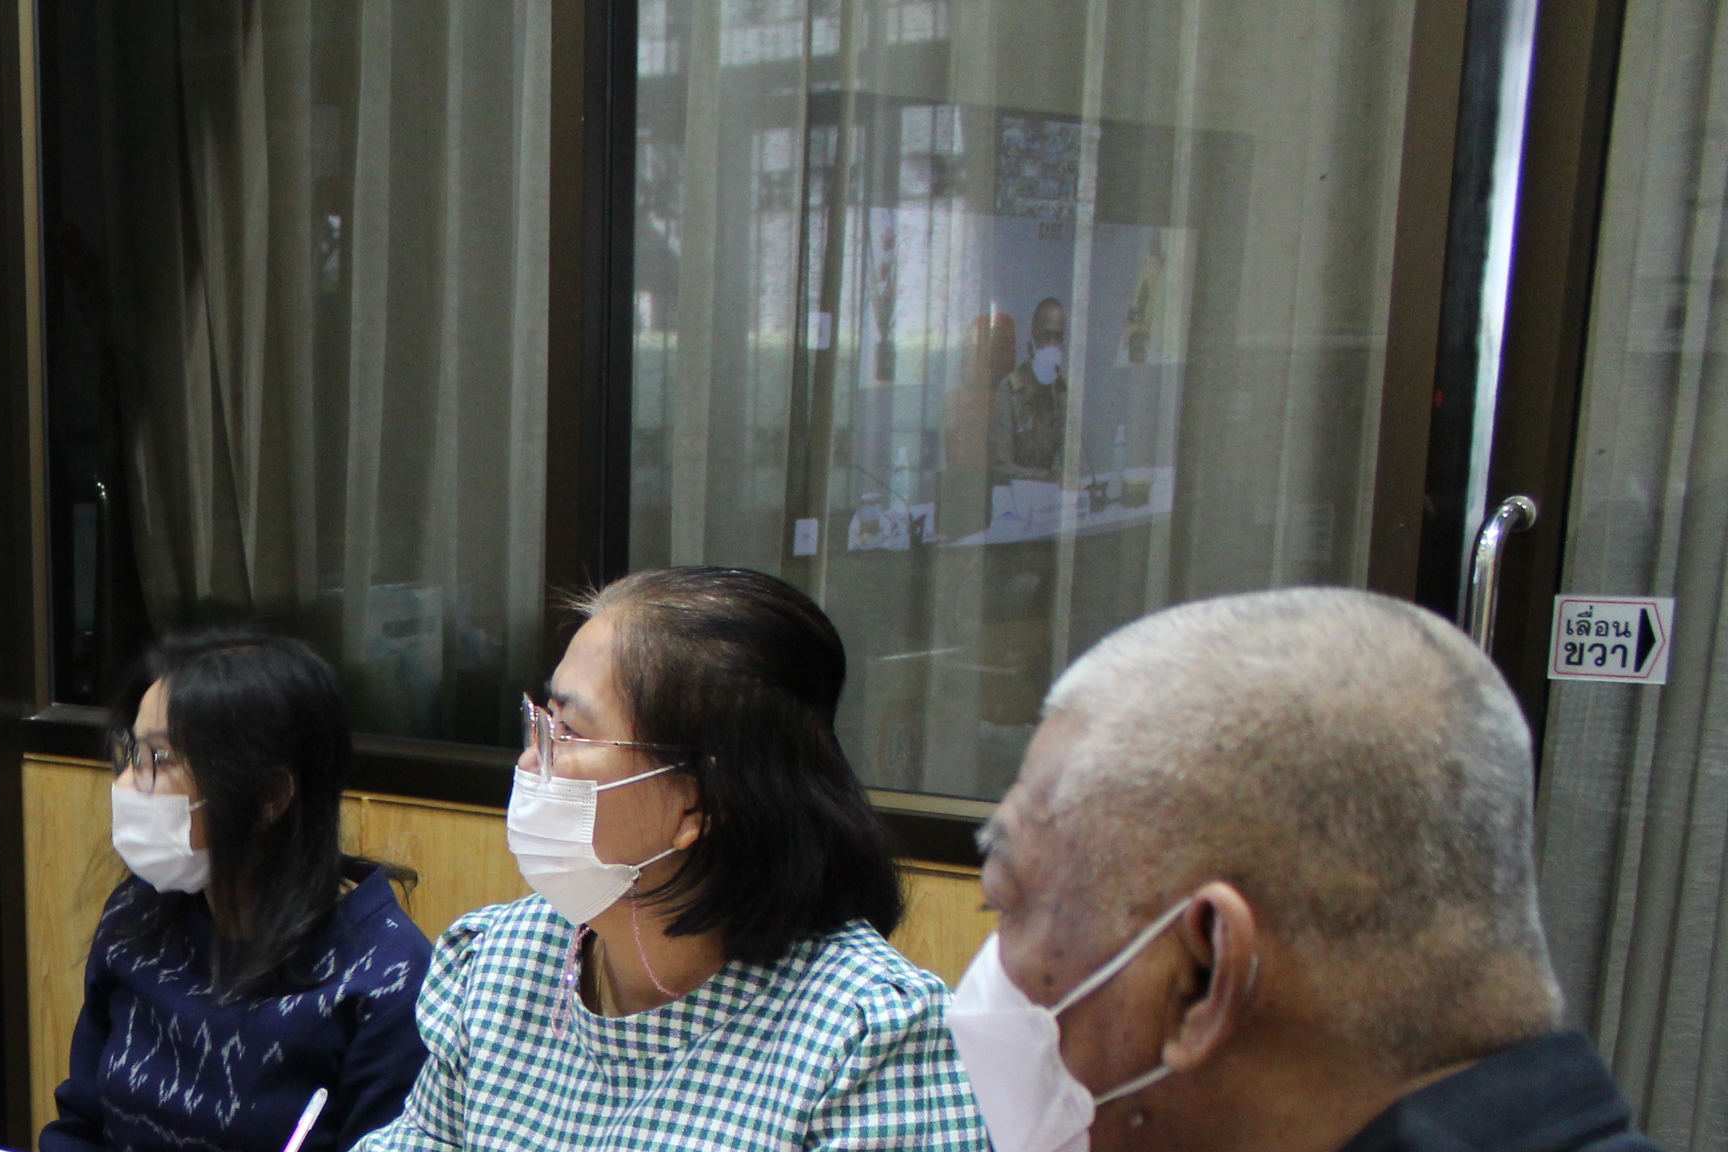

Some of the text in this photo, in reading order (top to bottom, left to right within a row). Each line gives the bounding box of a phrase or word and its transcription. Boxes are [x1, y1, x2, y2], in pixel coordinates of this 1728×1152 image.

[1566, 605, 1631, 638] เลื่อน
[1564, 641, 1628, 668] ขวา
